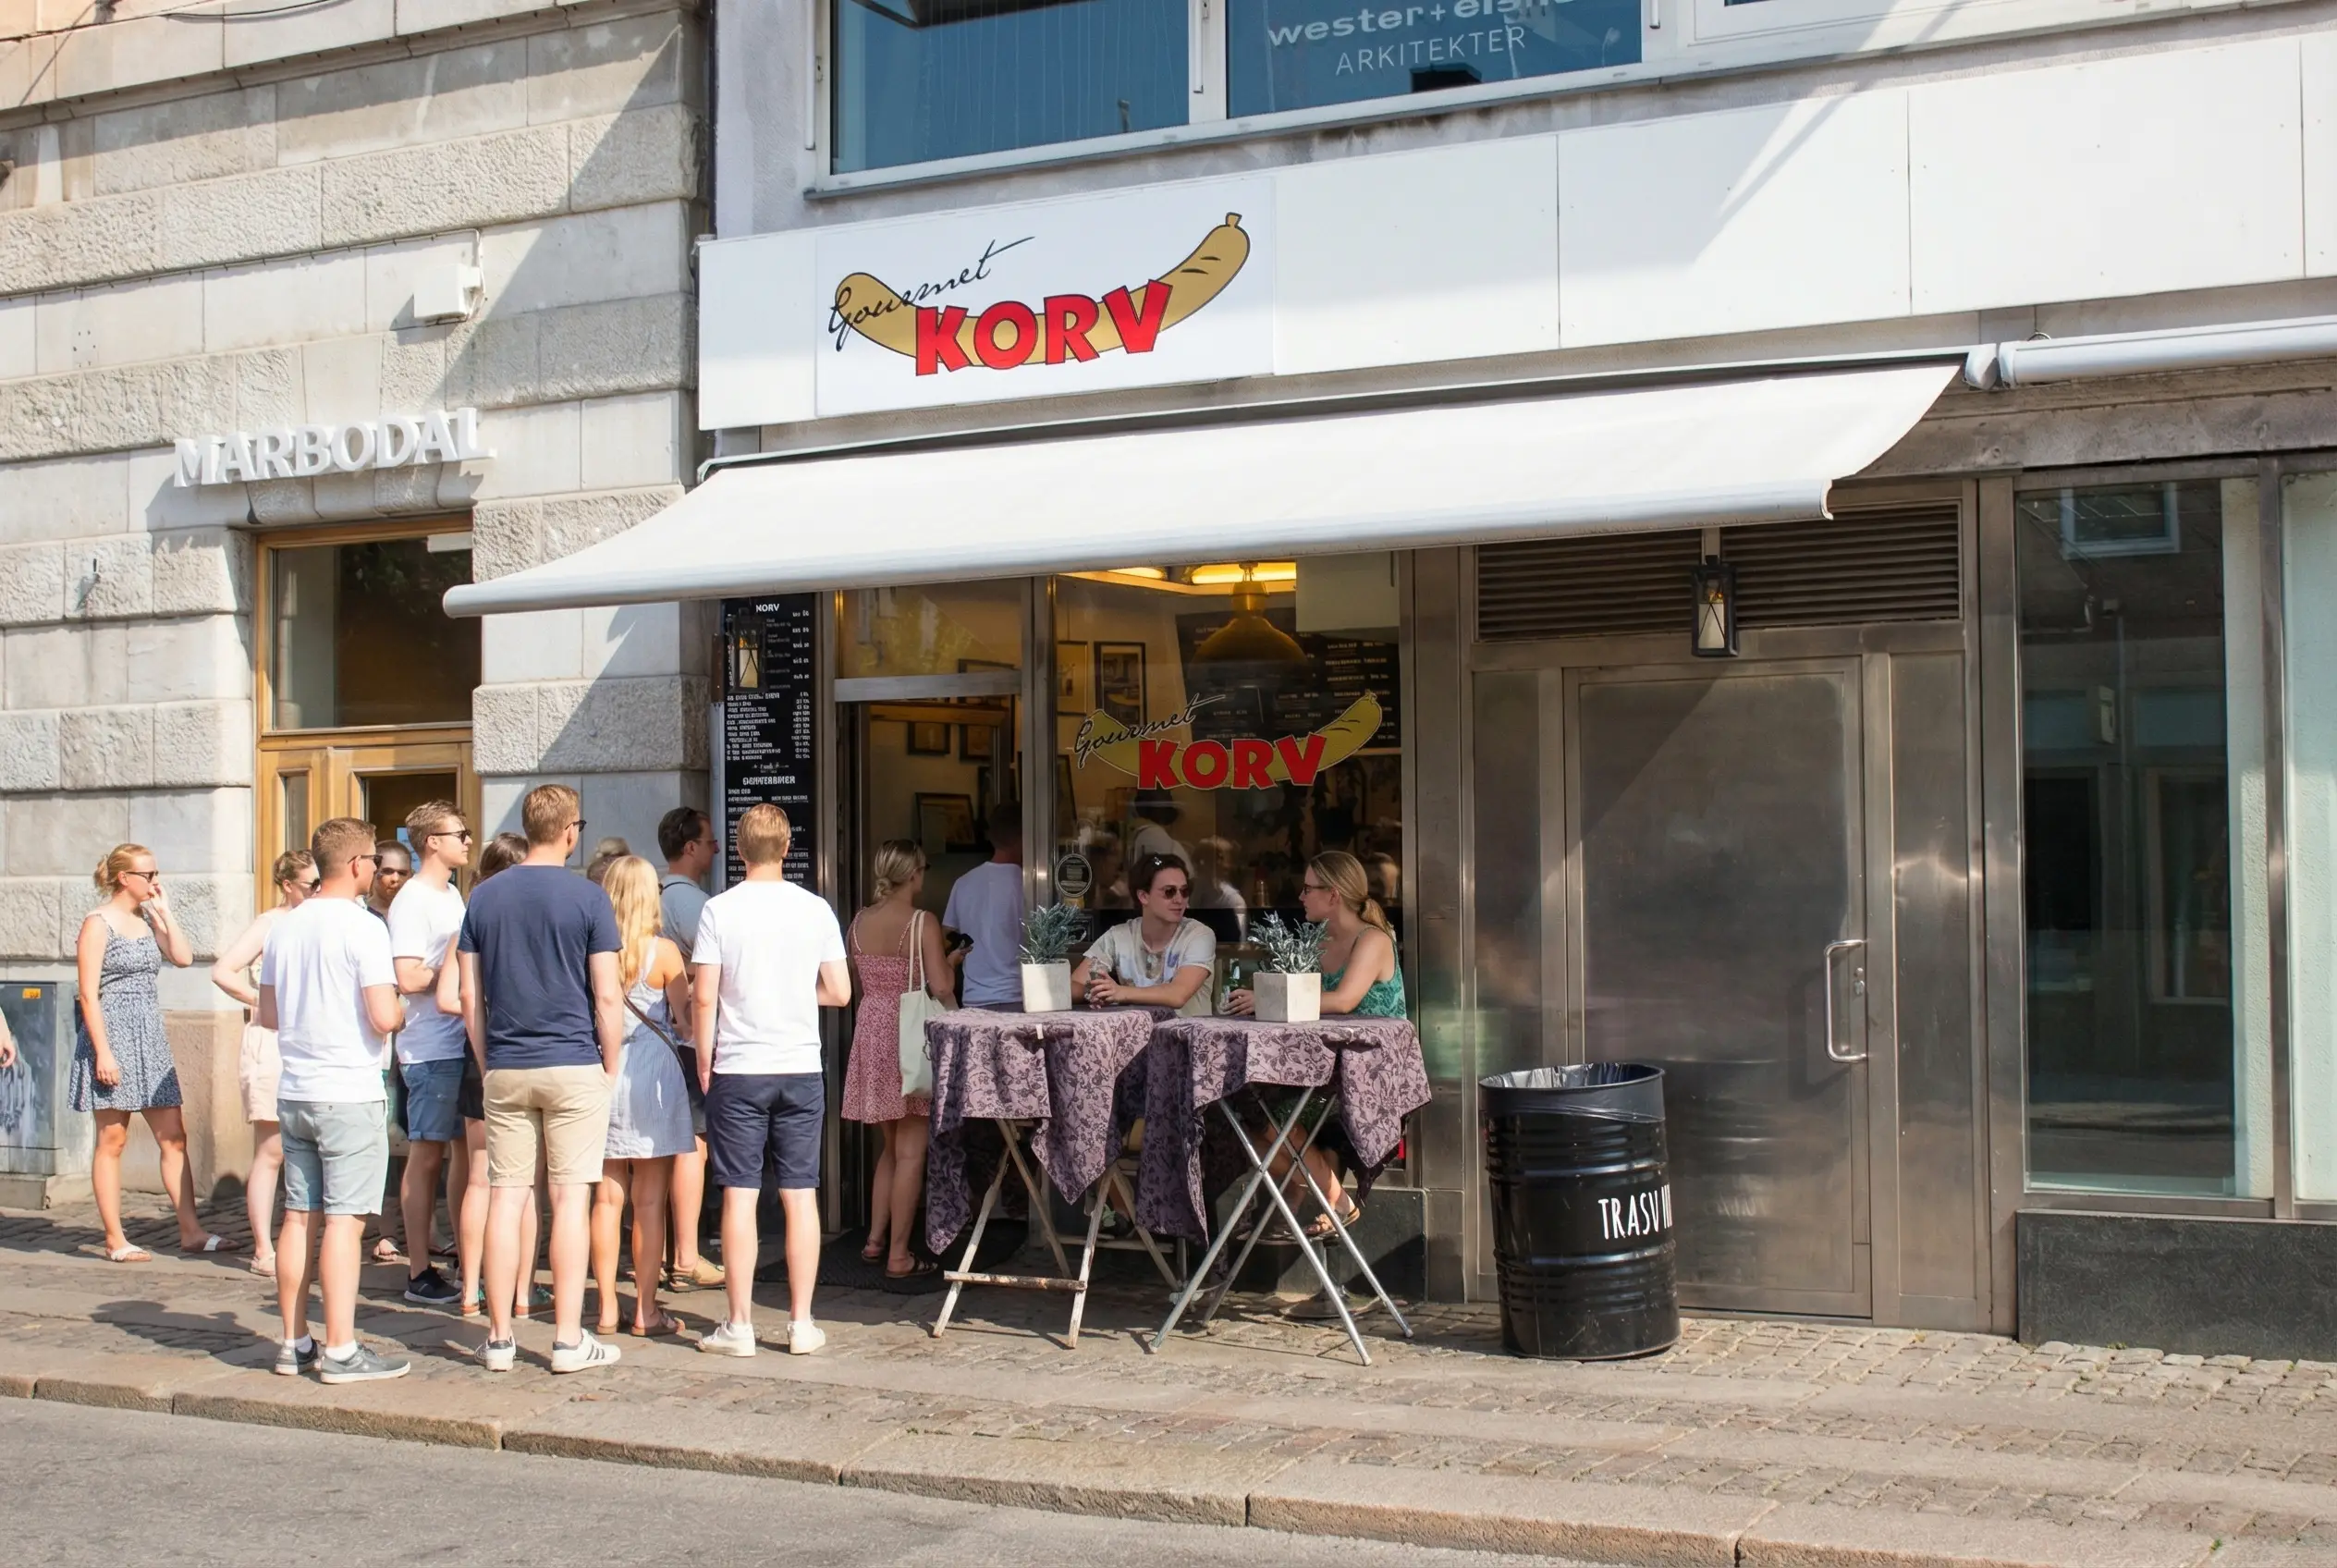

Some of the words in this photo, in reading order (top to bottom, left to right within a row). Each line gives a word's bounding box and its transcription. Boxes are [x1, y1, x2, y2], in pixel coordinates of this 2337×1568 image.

[1335, 26, 1526, 76] ARKITEKTER
[827, 236, 1034, 352] Gourmet
[915, 278, 1173, 376] KORV
[173, 407, 497, 487] MARBODAL
[1072, 692, 1227, 770] Gourmet
[1137, 731, 1328, 790] KORV
